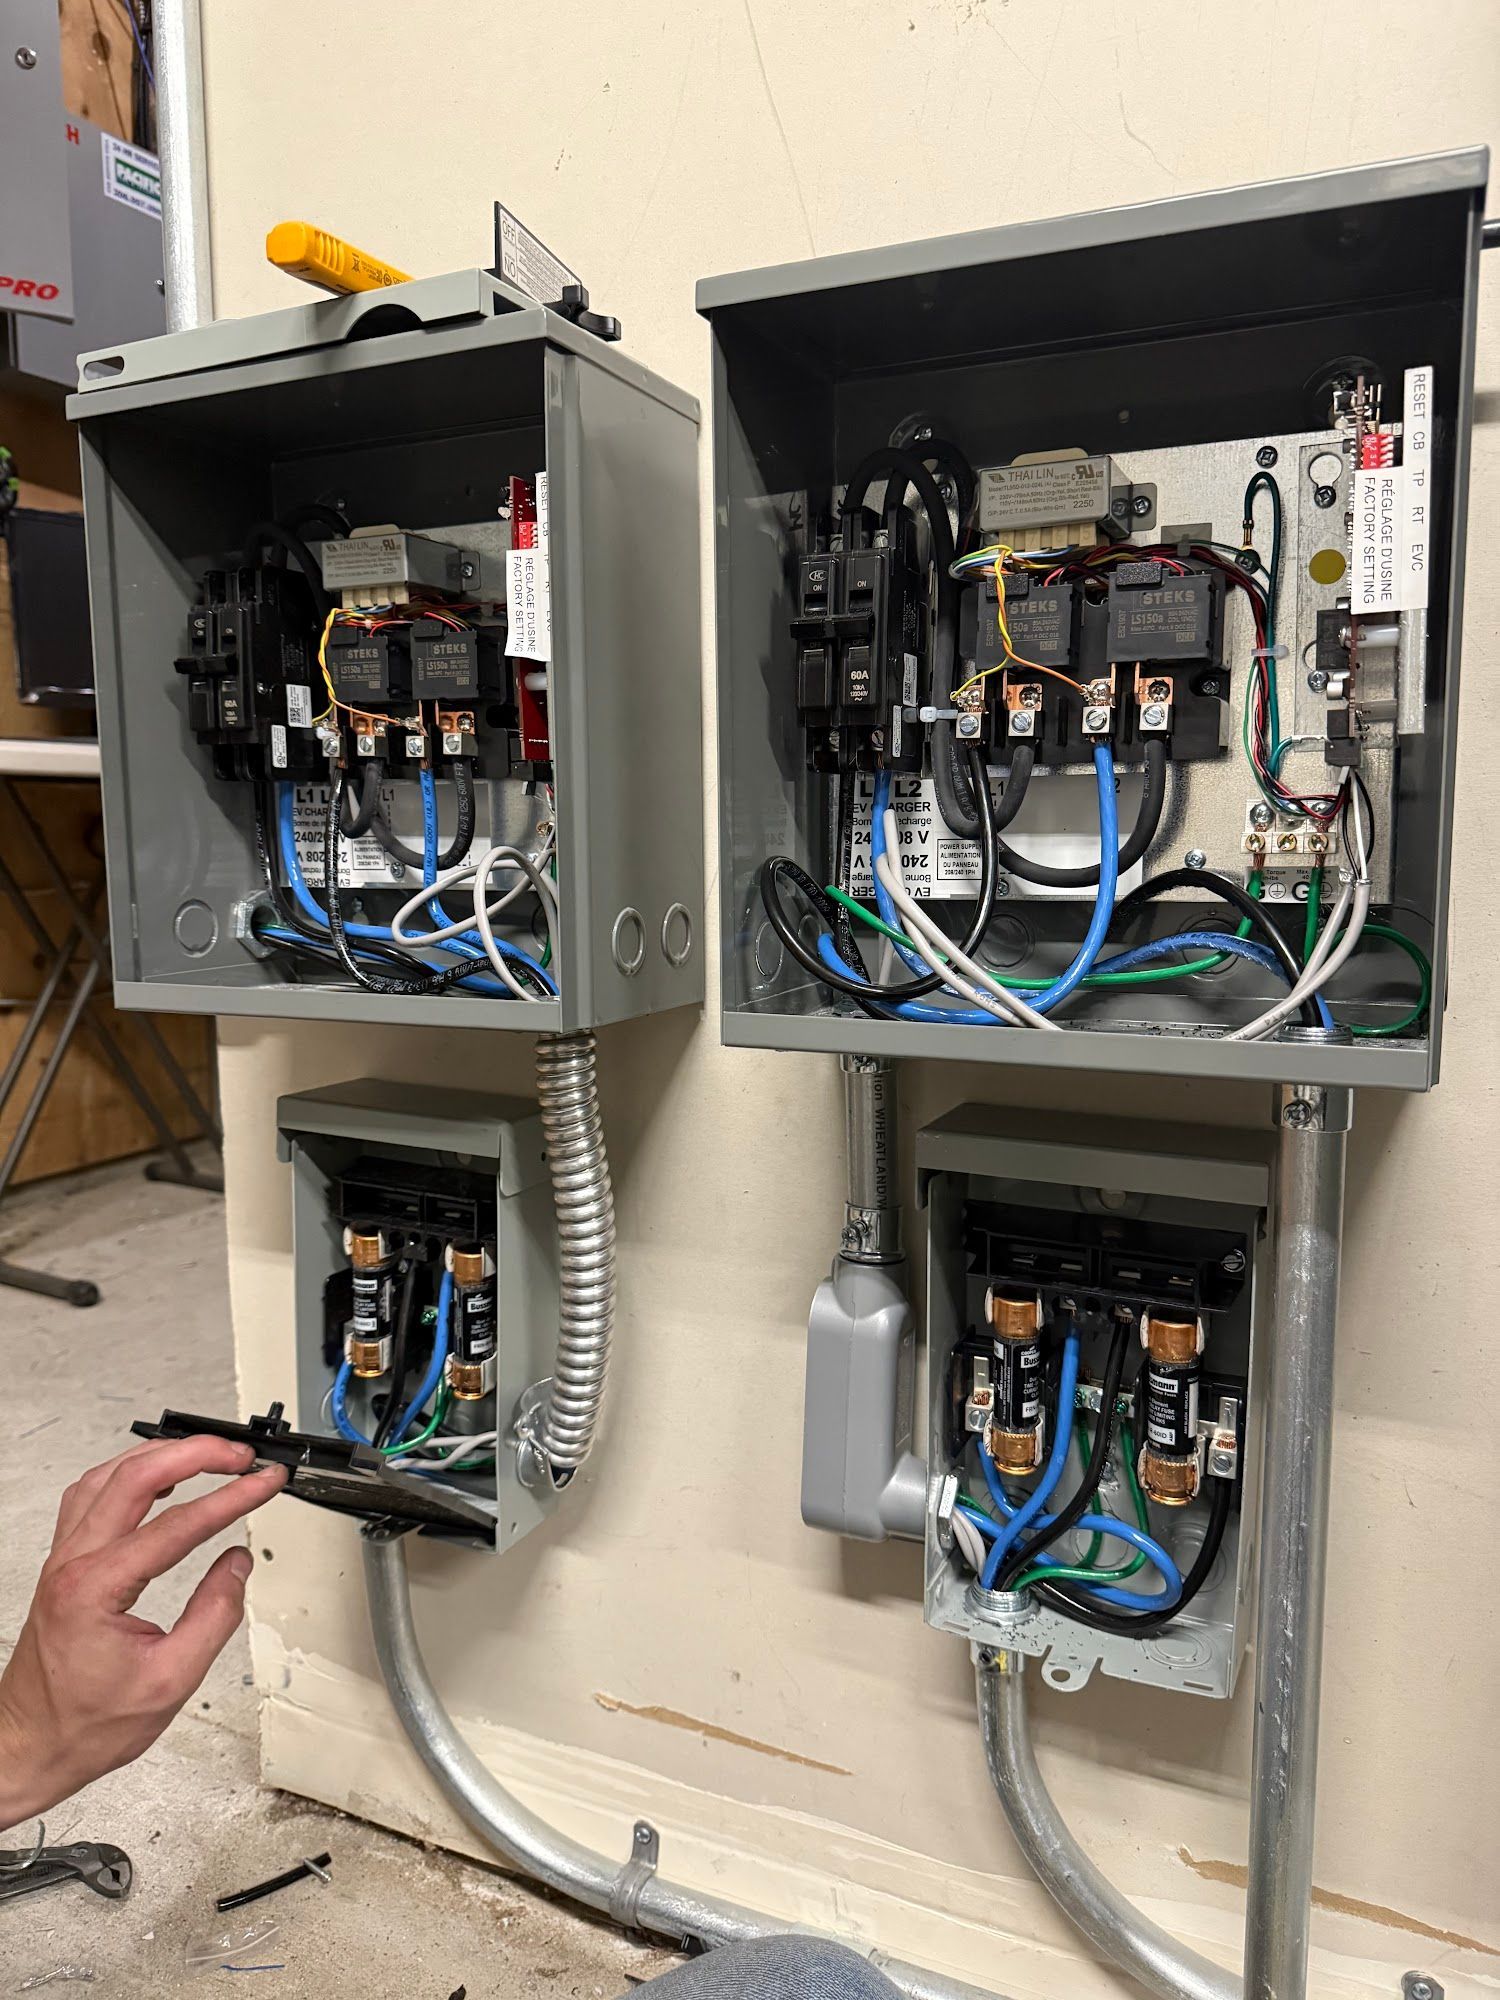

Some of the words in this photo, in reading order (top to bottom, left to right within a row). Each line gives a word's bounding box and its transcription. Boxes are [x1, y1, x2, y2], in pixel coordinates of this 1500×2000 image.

[1413, 373, 1426, 419] RESET
[1413, 431, 1425, 451] CB
[1008, 470, 1034, 482] THAI
[1036, 468, 1054, 479] LIN
[1412, 469, 1425, 487] TP
[1073, 500, 1094, 509] 2250
[1364, 477, 1376, 542] FACTORY
[1381, 479, 1395, 544] RÉGLAGE
[1411, 506, 1424, 524] RT
[1411, 544, 1424, 572] EVC
[513, 556, 524, 607] FACTORY
[1363, 546, 1375, 604] SETTING
[1381, 548, 1393, 601] D'USINE
[525, 557, 535, 609] RÉGLAGE
[1143, 589, 1195, 605] STEKS
[1010, 600, 1058, 615] STEKS
[1131, 613, 1164, 625] LS150a
[527, 612, 536, 653] D'USINE
[347, 649, 379, 659] STEKS
[433, 643, 468, 654] STEKS
[850, 670, 869, 681] 60A
[296, 788, 314, 803] L1
[382, 788, 395, 801] L1
[860, 781, 873, 797] L
[895, 780, 922, 797] L2
[305, 807, 328, 816] CHAR
[918, 831, 930, 844] V
[1153, 1410, 1176, 1421] LIMITING
[1160, 1406, 1176, 1415] FUSE
